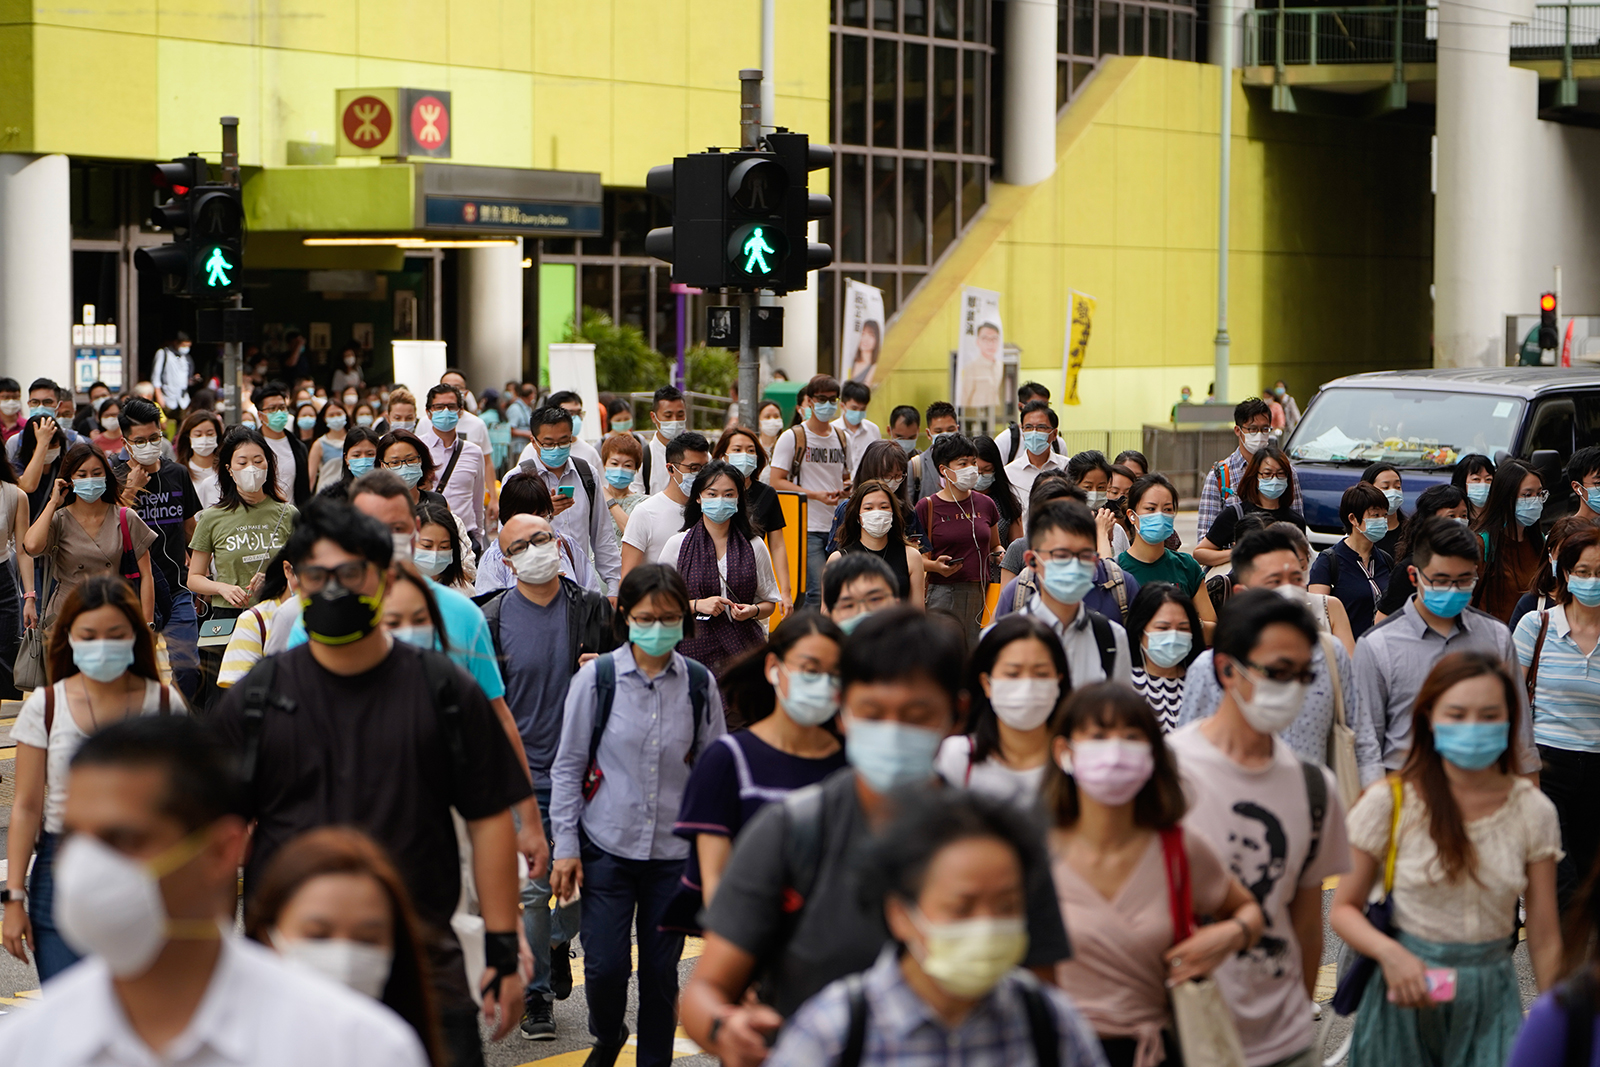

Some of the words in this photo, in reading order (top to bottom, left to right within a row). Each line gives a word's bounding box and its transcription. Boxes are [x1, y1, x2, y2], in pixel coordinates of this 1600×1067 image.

[810, 447, 827, 463] HONG
[140, 492, 169, 506] new
[137, 505, 183, 520] alance
